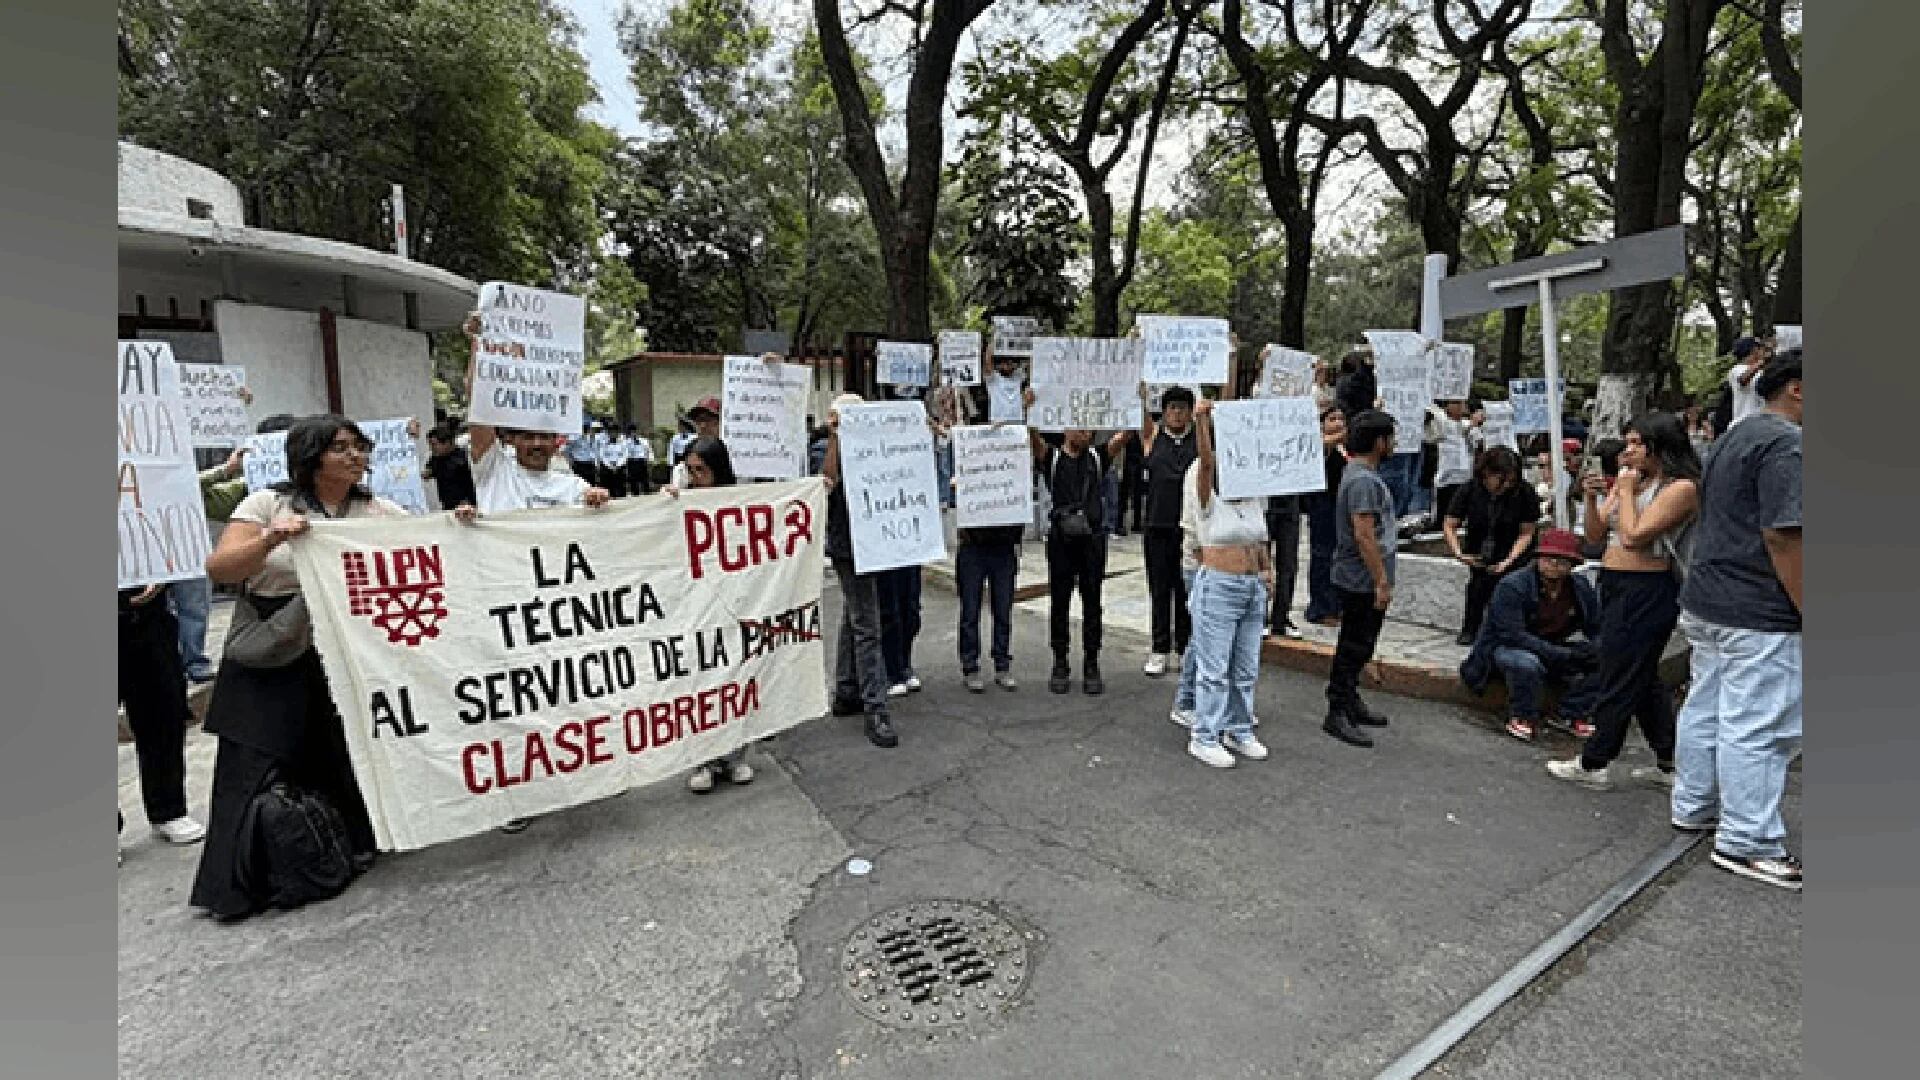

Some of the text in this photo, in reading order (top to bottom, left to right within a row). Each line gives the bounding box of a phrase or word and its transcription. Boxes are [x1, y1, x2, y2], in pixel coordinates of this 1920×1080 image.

[373, 544, 443, 585] IPN
[530, 543, 595, 588] LA
[684, 504, 778, 579] PCR
[488, 582, 665, 649] TÉCNICA
[371, 686, 429, 739] AL
[454, 645, 636, 725] SERVICIO
[650, 632, 689, 682] DE
[695, 626, 728, 673] LA
[462, 678, 761, 795] CLASE OBRERA
